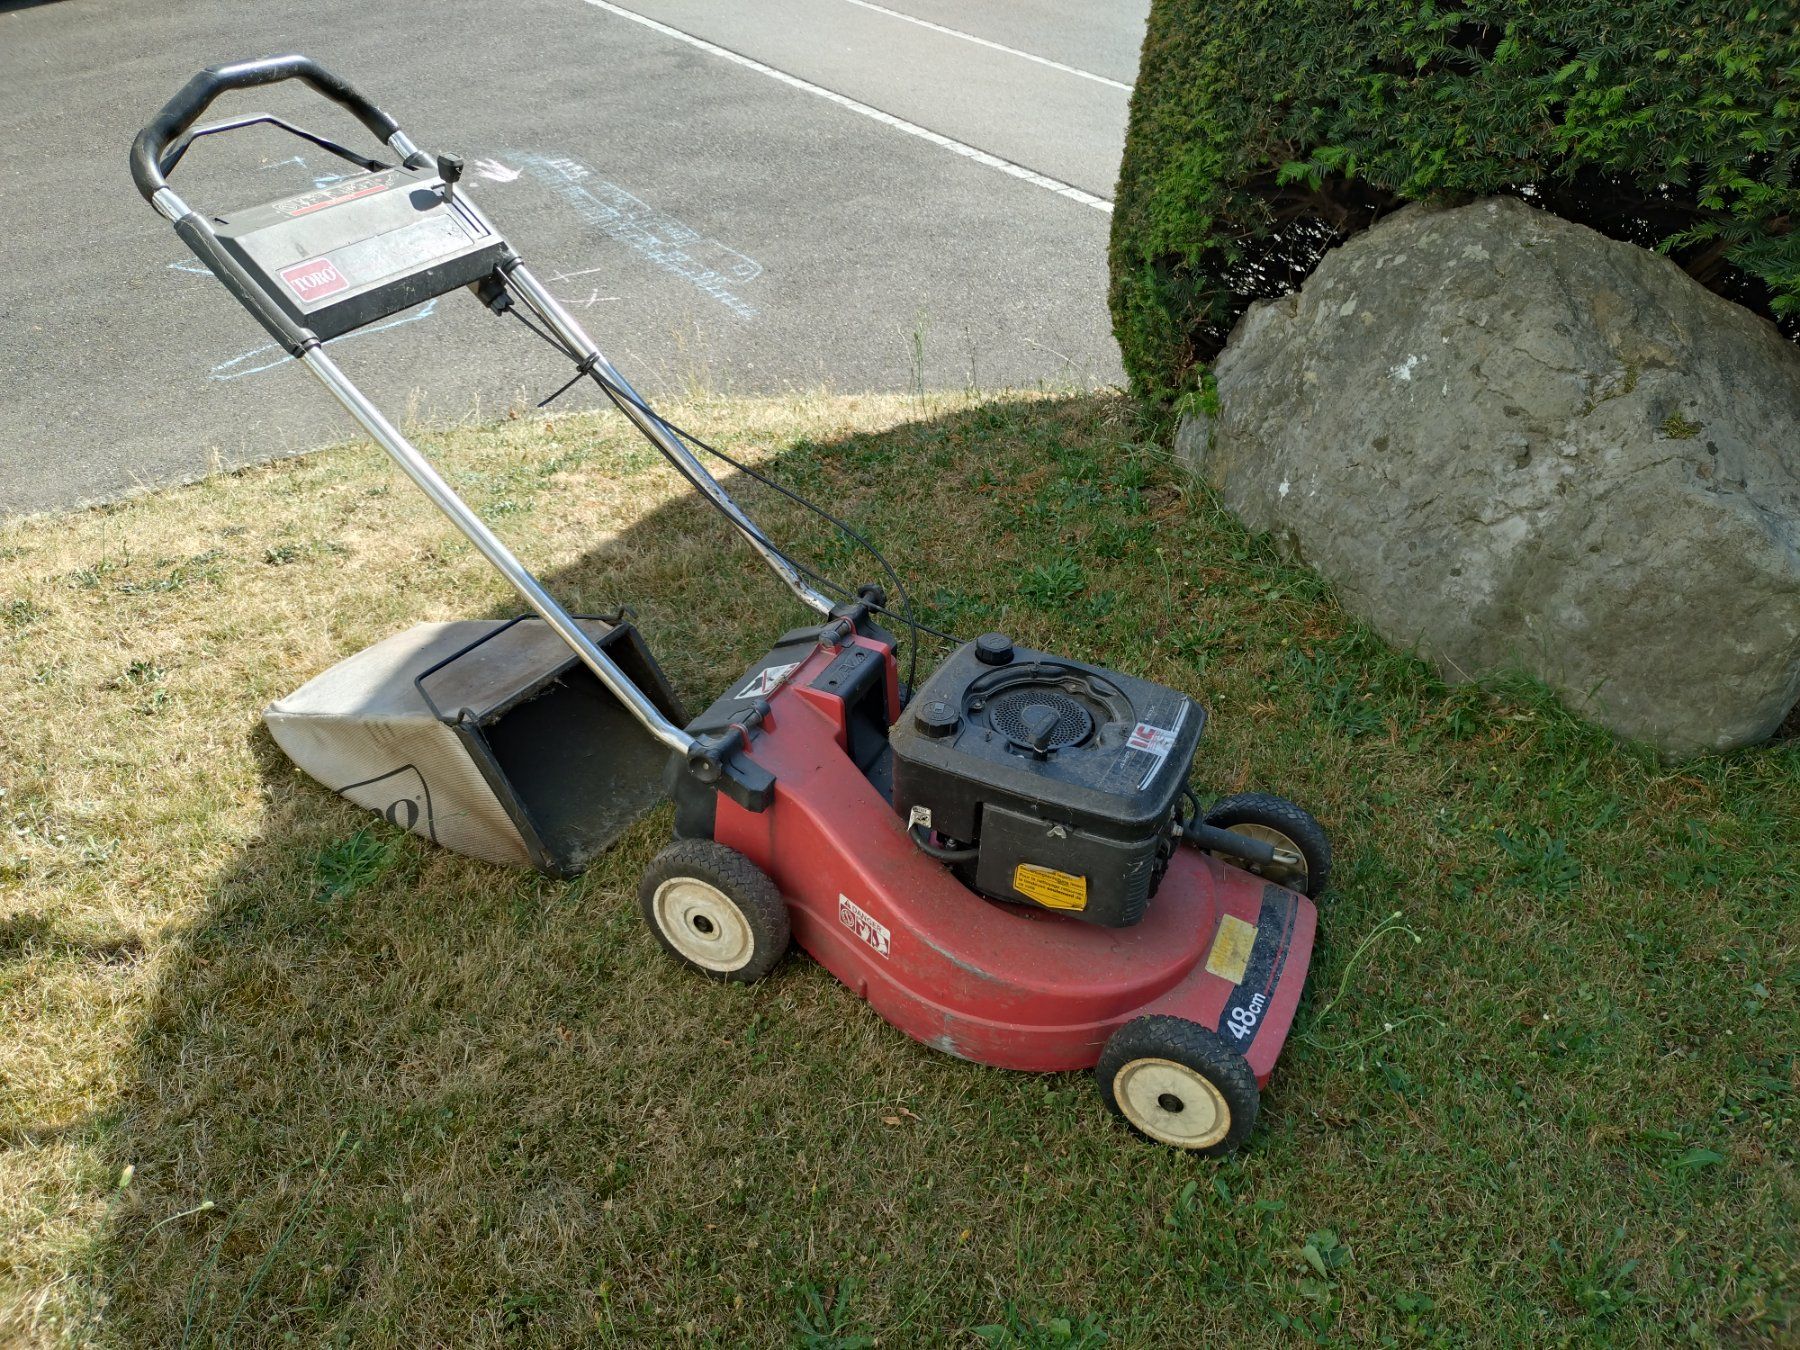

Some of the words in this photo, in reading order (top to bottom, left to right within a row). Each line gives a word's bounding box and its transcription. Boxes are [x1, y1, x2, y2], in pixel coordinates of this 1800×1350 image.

[291, 268, 337, 292] TORO
[851, 904, 882, 932] DANGER
[1227, 992, 1266, 1039] 48cm
